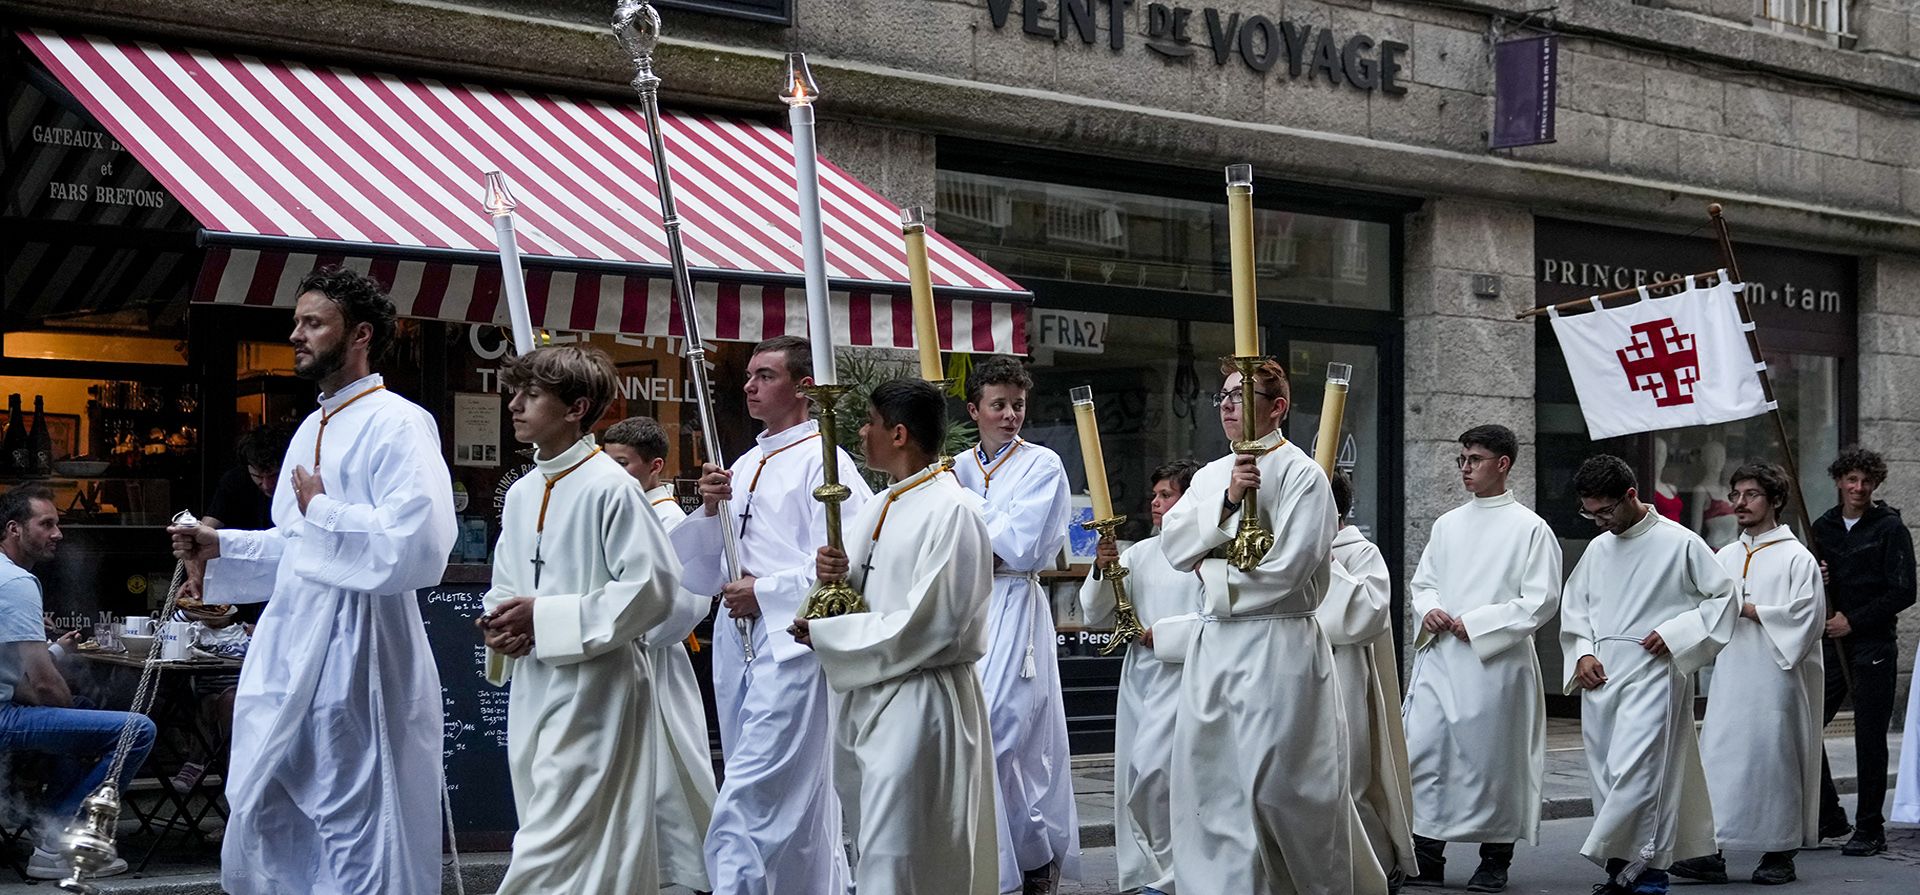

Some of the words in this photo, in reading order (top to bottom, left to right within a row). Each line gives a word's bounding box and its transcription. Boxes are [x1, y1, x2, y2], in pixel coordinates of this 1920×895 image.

[1148, 3, 1193, 43] DE
[1204, 7, 1410, 95] VOYAGE
[32, 125, 103, 150] GATEAUX
[100, 161, 114, 176] et
[49, 181, 88, 201] FARS
[95, 185, 164, 208] BRETONS
[1543, 259, 1684, 296] PRINCESS
[427, 591, 473, 604] GALETTES
